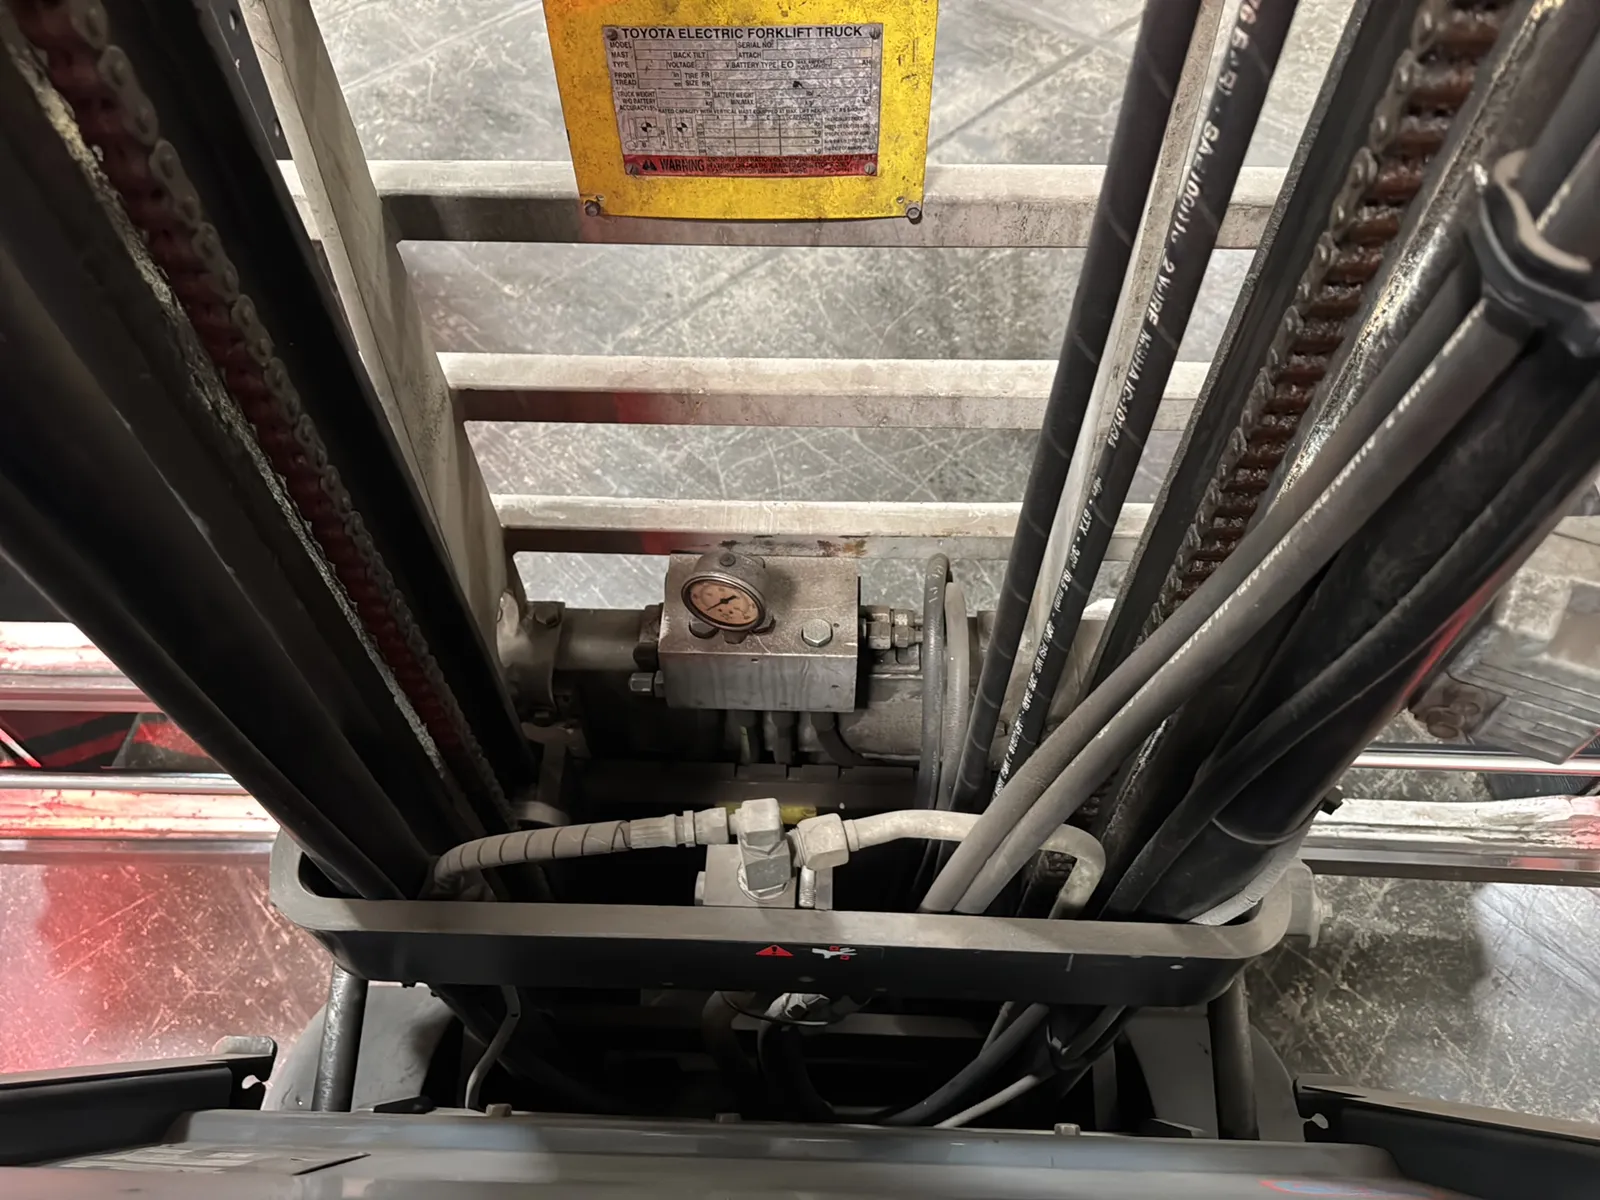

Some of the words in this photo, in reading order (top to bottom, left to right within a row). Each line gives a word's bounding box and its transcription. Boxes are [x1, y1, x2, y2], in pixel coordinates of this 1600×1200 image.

[622, 28, 675, 38] TOYOTA
[679, 28, 744, 38] ELECTRIC
[748, 27, 812, 38] FORKLIFT
[816, 26, 862, 37] TRUCK
[660, 159, 704, 171] WARNING
[1161, 255, 1176, 274] 2
[1144, 273, 1170, 326] WIRE
[1037, 639, 1049, 659] PSI
